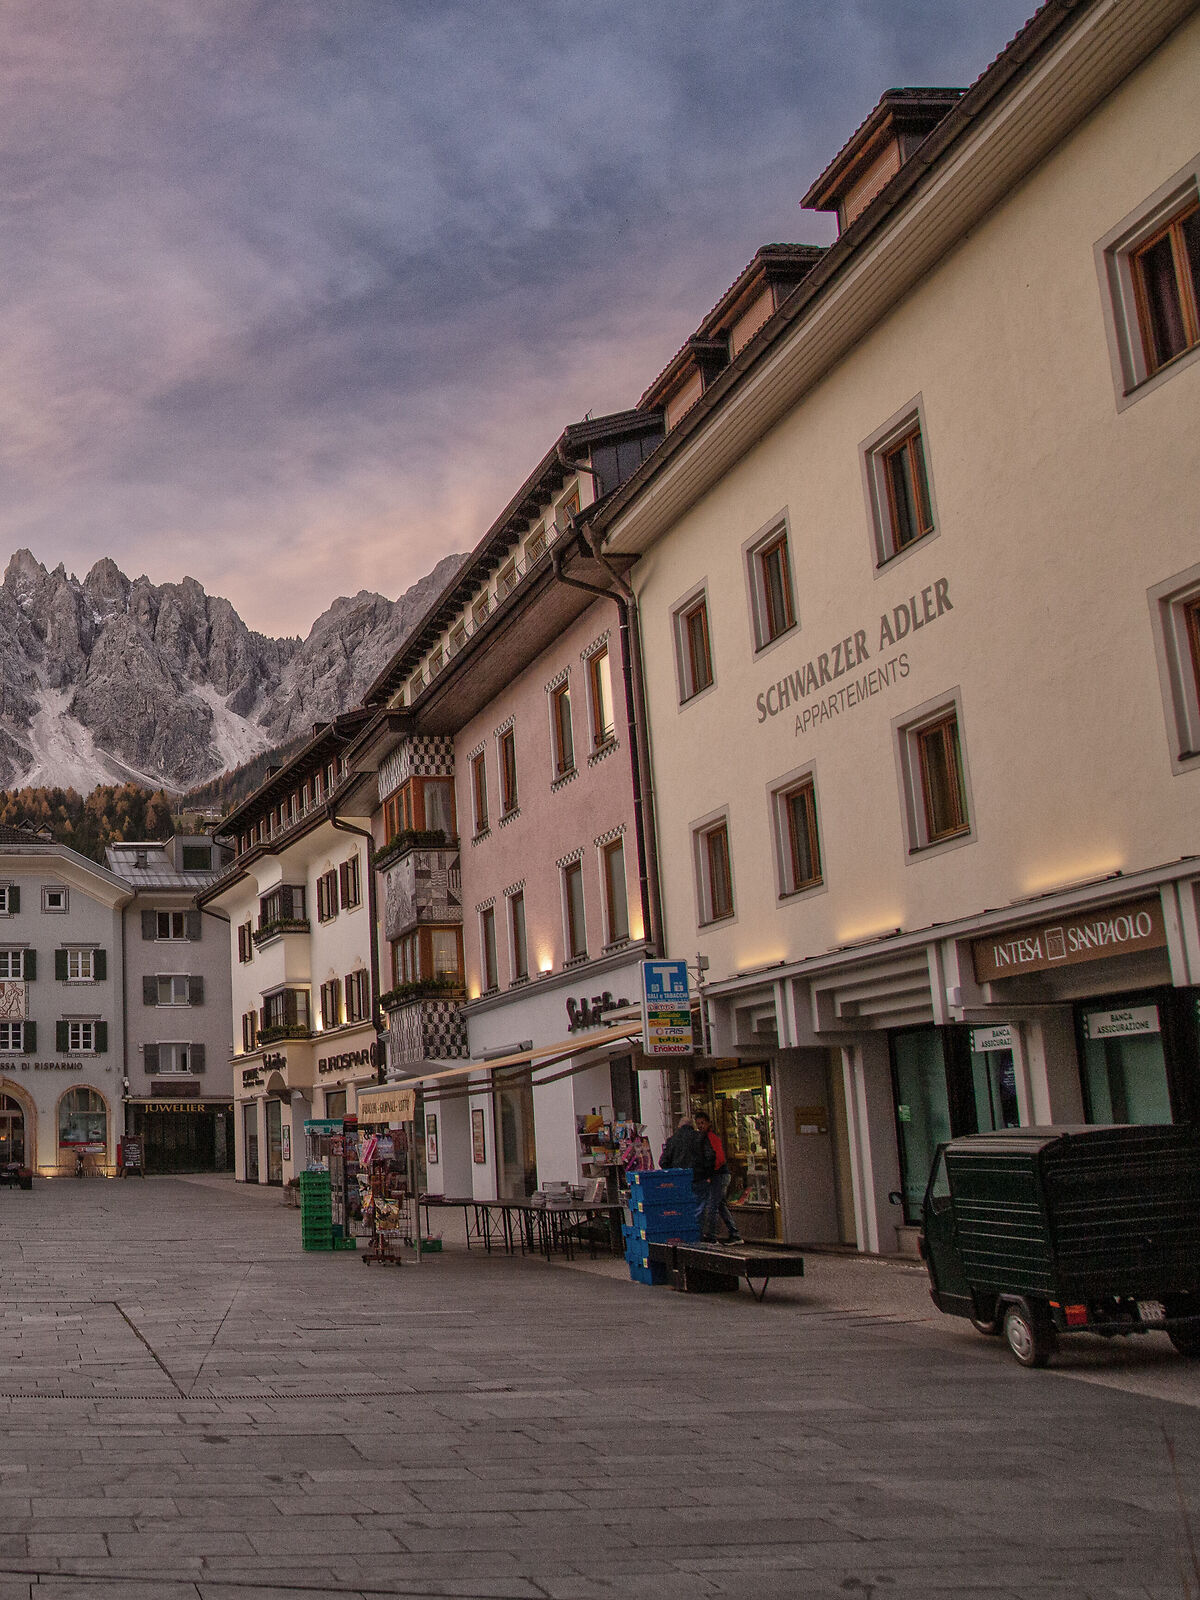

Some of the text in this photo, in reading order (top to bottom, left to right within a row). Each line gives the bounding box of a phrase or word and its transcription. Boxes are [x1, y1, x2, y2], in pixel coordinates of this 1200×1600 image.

[756, 577, 954, 724] SCHWARZER ADLER
[794, 653, 911, 737] APPARTEMENTS
[993, 911, 1152, 968] INTESA SANPAOLO
[1110, 1012, 1134, 1022] BANCA
[663, 1027, 685, 1035] TRIS
[1097, 1020, 1150, 1034] ASSICURAZIONE
[991, 1029, 1011, 1037] BANCA
[653, 1045, 685, 1053] Enalotto
[34, 1061, 83, 1071] RISPARMIO
[318, 1048, 370, 1074] EUROSPAR
[145, 1103, 205, 1113] JUWELIER
